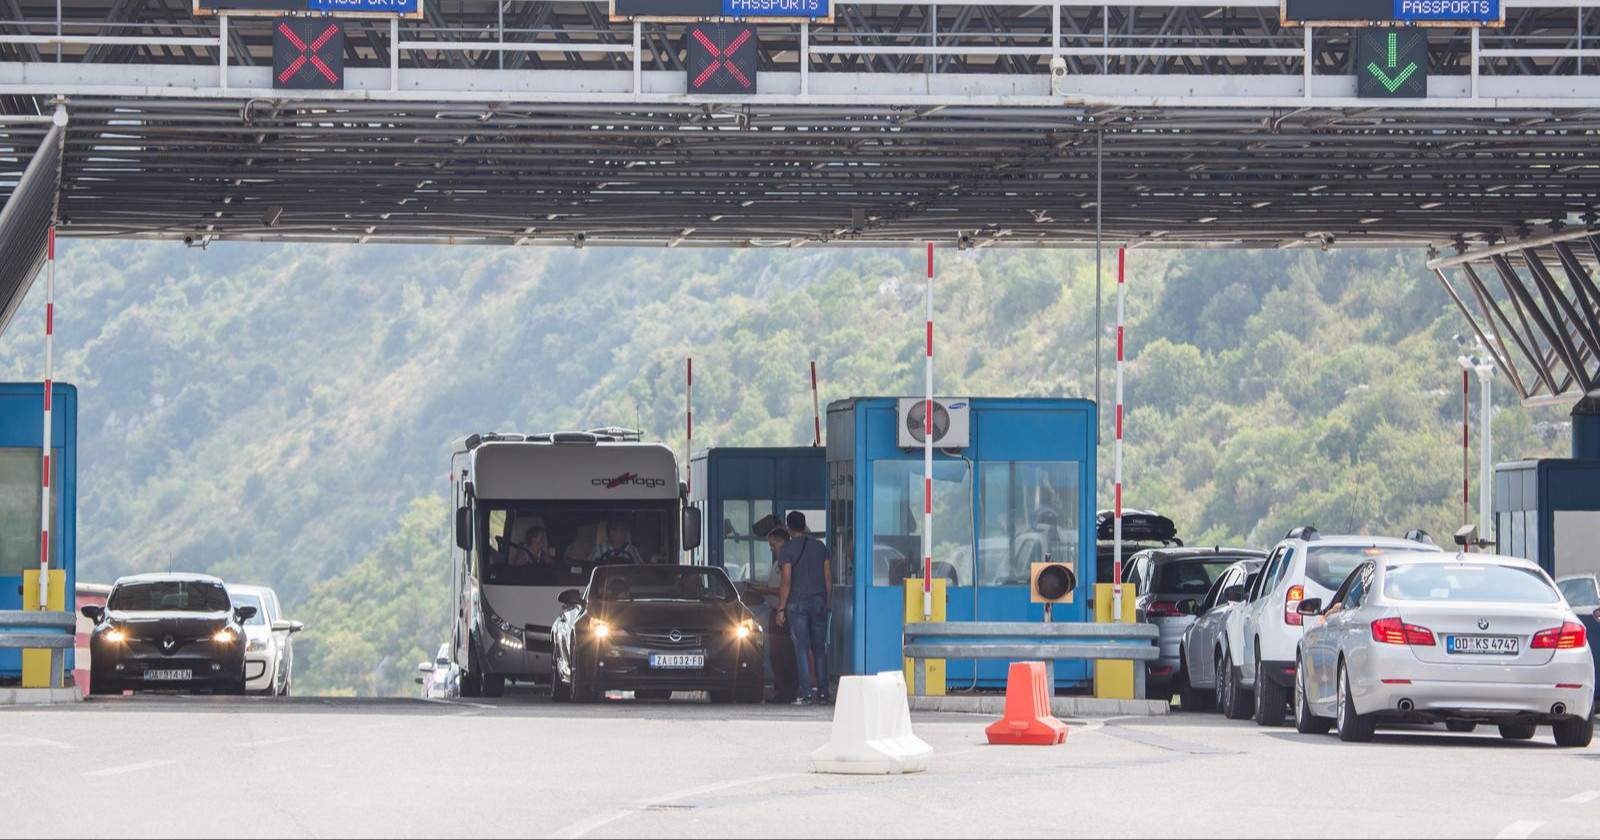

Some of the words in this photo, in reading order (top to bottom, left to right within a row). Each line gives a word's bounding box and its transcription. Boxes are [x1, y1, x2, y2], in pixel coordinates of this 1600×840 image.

[1402, 0, 1490, 13] PASSPORTS
[1455, 638, 1468, 649] OD
[1475, 638, 1488, 650] KS
[1491, 639, 1517, 650] 4747
[657, 656, 667, 665] ZA
